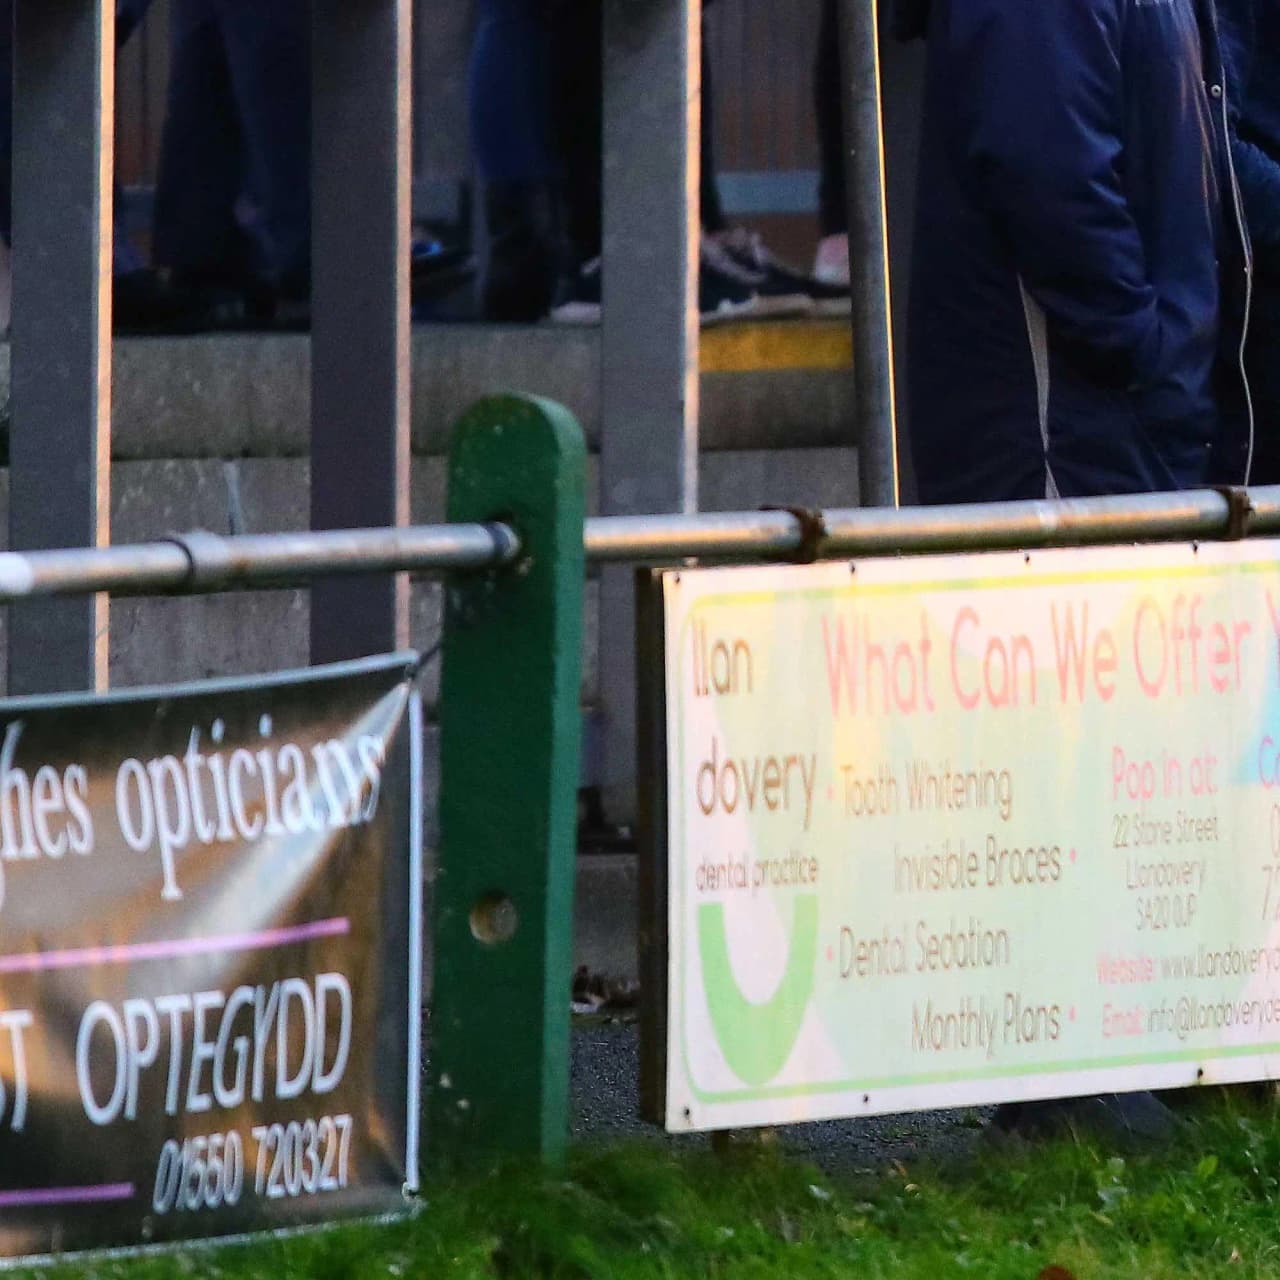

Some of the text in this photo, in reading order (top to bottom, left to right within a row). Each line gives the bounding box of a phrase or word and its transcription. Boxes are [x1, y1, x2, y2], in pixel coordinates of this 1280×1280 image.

[822, 615, 934, 716] What
[951, 607, 1038, 711] Can
[1052, 600, 1118, 704] We
[1133, 594, 1250, 699] Offer
[697, 736, 817, 831] dovery
[841, 758, 1013, 821] Tooth Whitening
[1111, 745, 1155, 801] Pop
[1162, 748, 1182, 798] in
[115, 714, 387, 900] opticians
[696, 847, 819, 898] dental practice
[894, 832, 1062, 894] Invisible Braces
[840, 917, 1010, 978] Dental Sedation
[76, 972, 352, 1126] OPTEGYDD
[912, 991, 1062, 1058] Monthly Plans
[152, 1114, 352, 1215] 01550 720327
